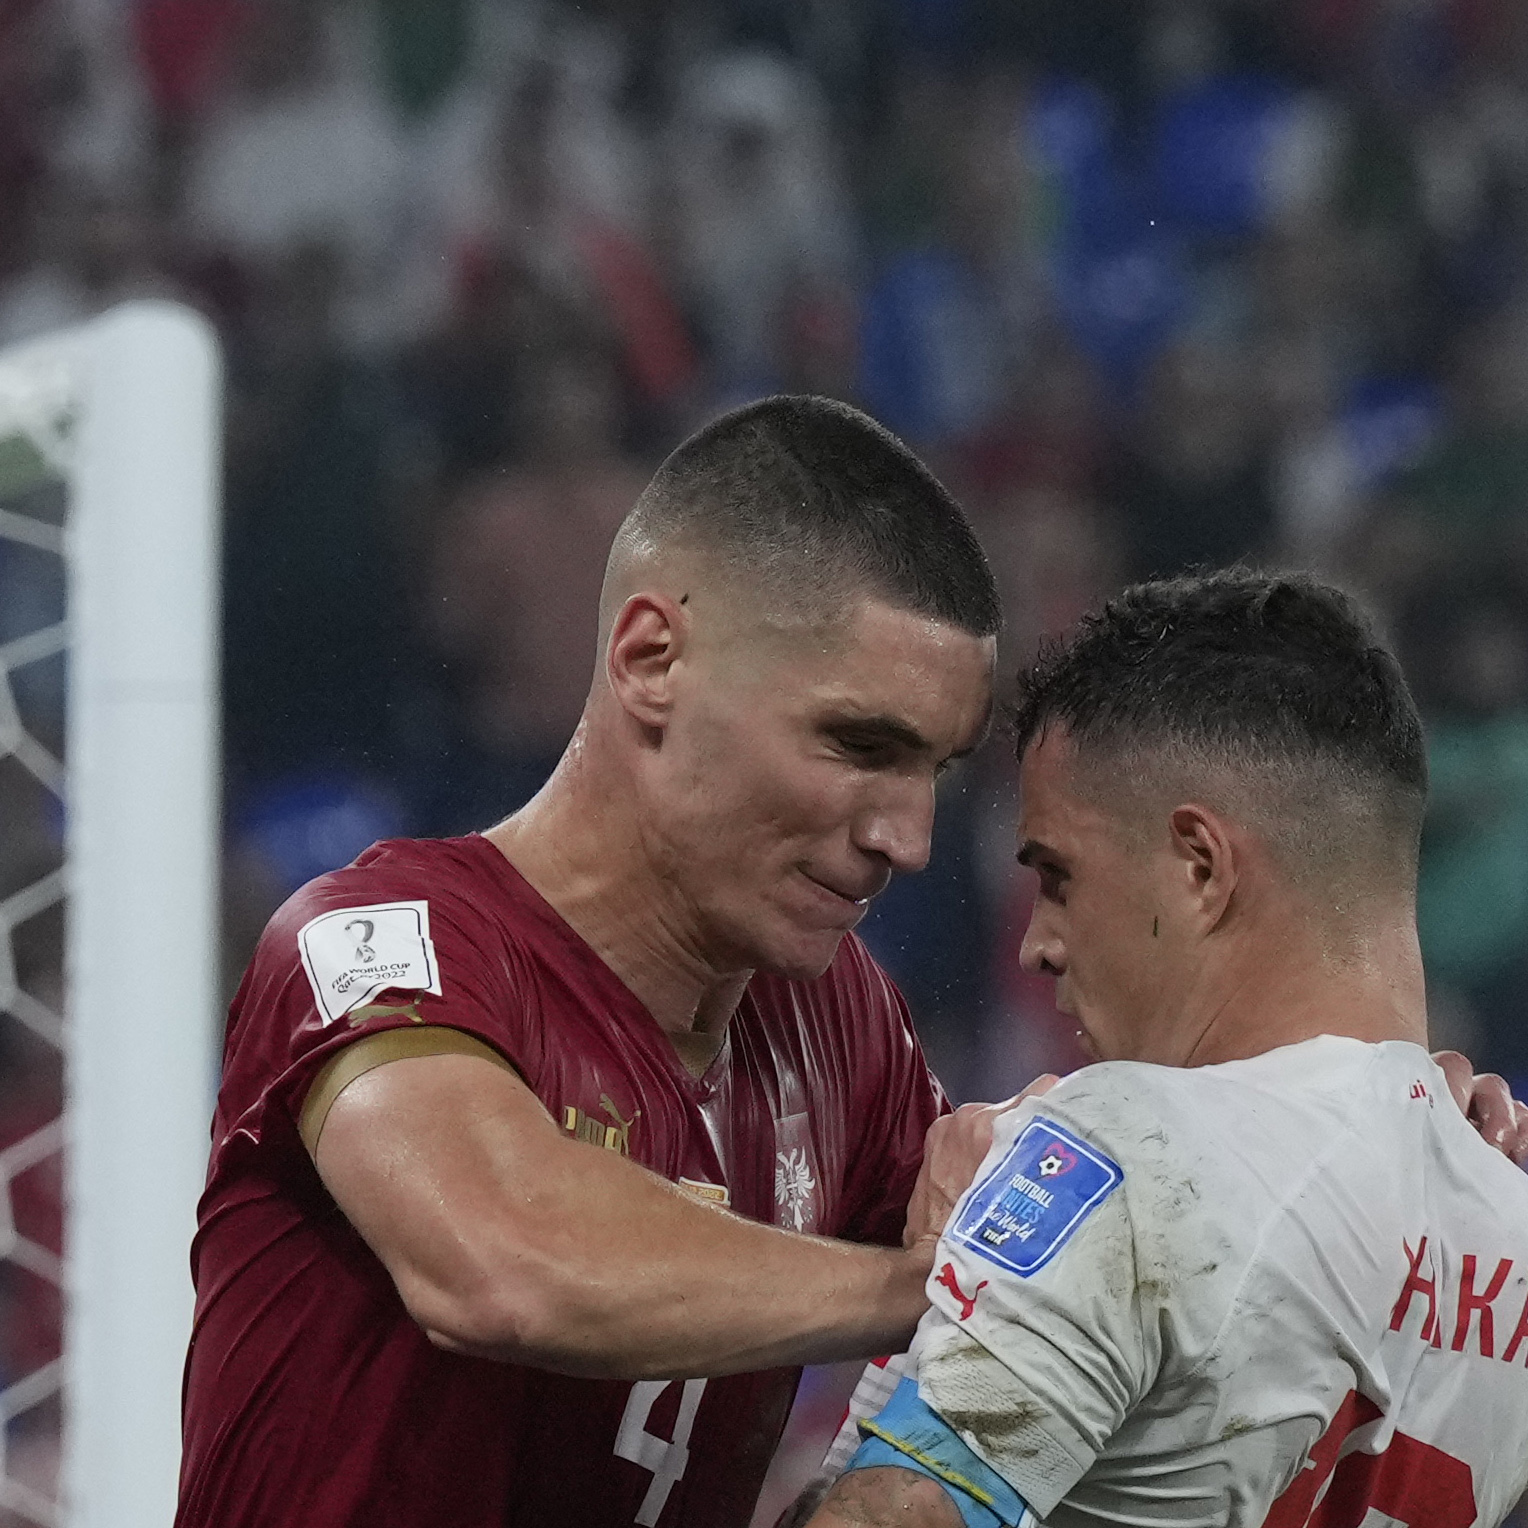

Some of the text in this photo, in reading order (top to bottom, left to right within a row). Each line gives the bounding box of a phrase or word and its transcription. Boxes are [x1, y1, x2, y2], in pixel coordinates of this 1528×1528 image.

[348, 963, 389, 975] WORLD
[389, 962, 411, 971] CUP
[996, 1187, 1045, 1224] NITES
[1008, 1173, 1055, 1209] FOOTBALL
[612, 1377, 708, 1528] 4
